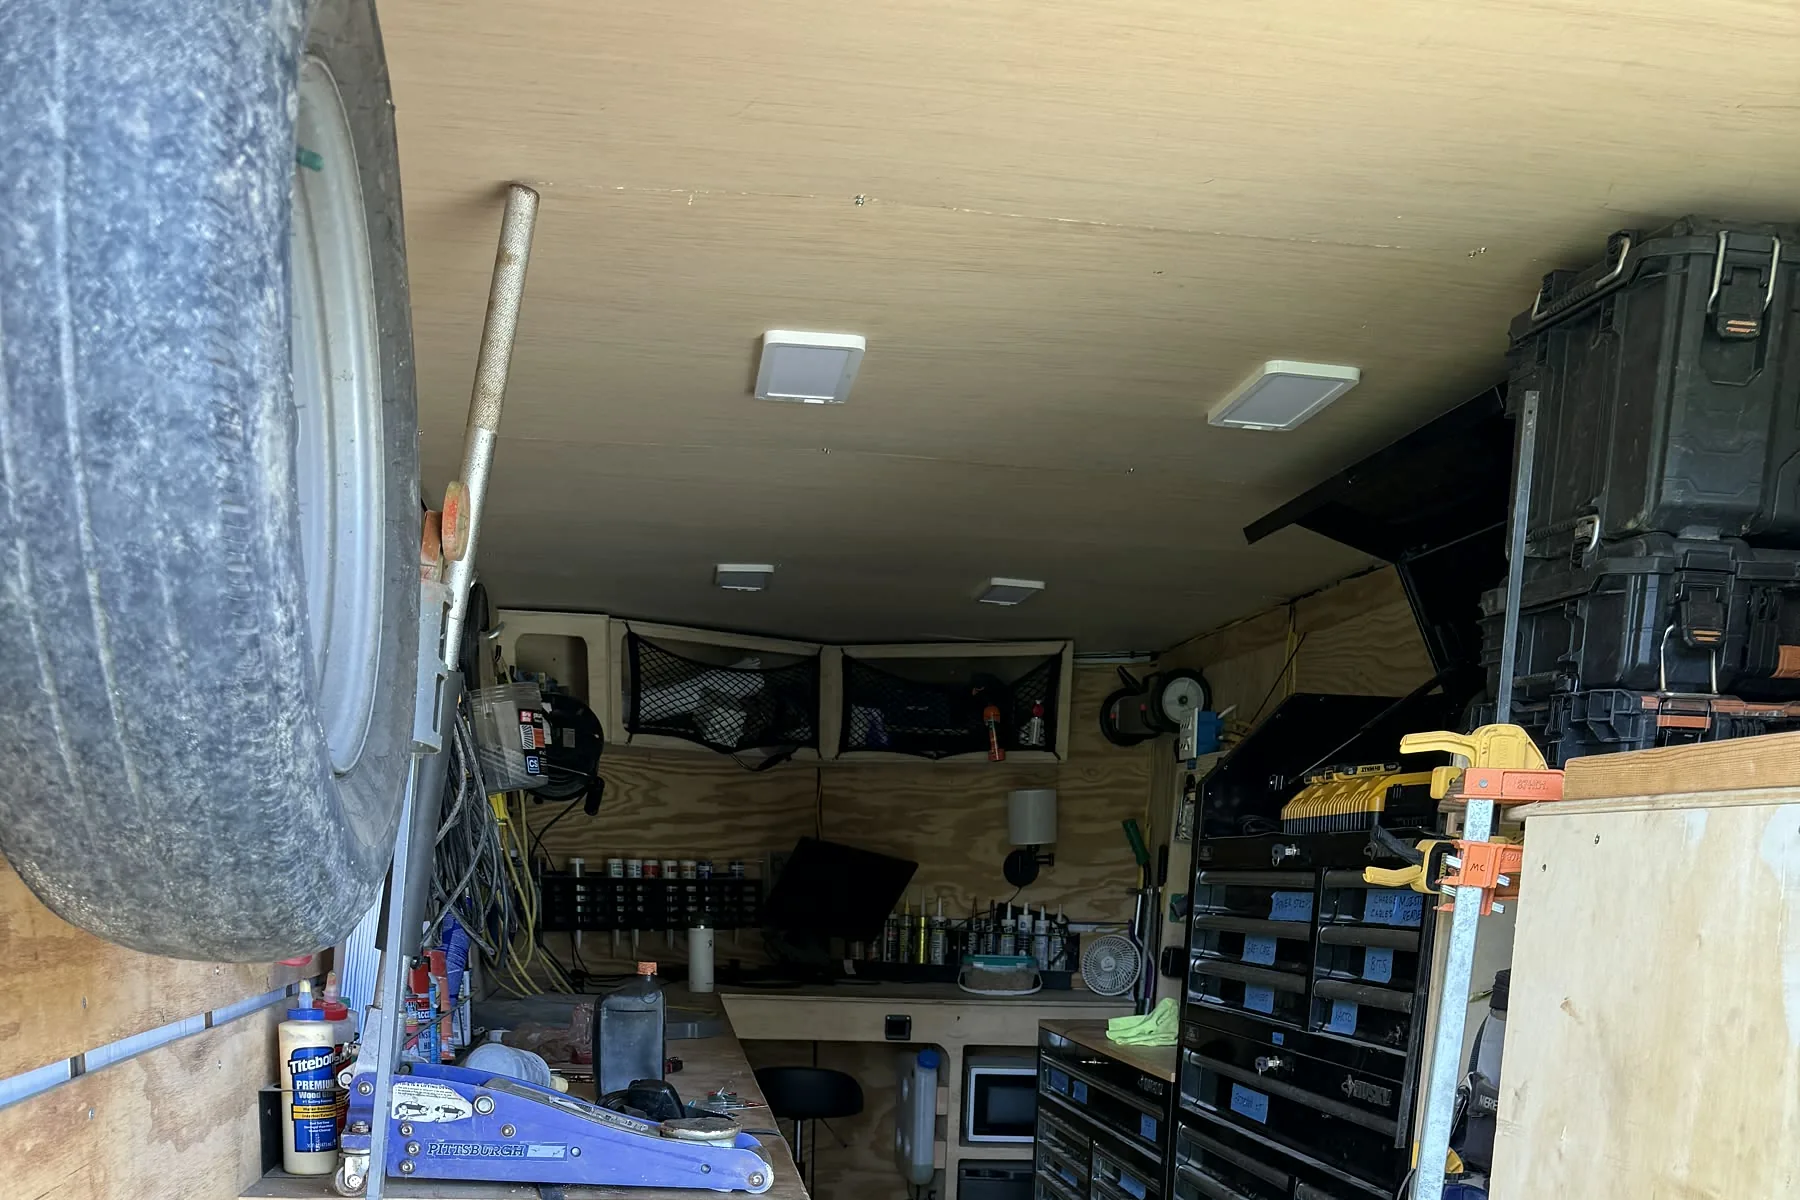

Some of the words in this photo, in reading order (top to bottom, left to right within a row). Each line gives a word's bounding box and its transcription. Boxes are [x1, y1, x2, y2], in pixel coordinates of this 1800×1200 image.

[1469, 863, 1485, 872] MC
[289, 1053, 335, 1074] Titebon
[296, 1079, 335, 1090] PREMIUM
[427, 1142, 525, 1156] PITTSBURGH
